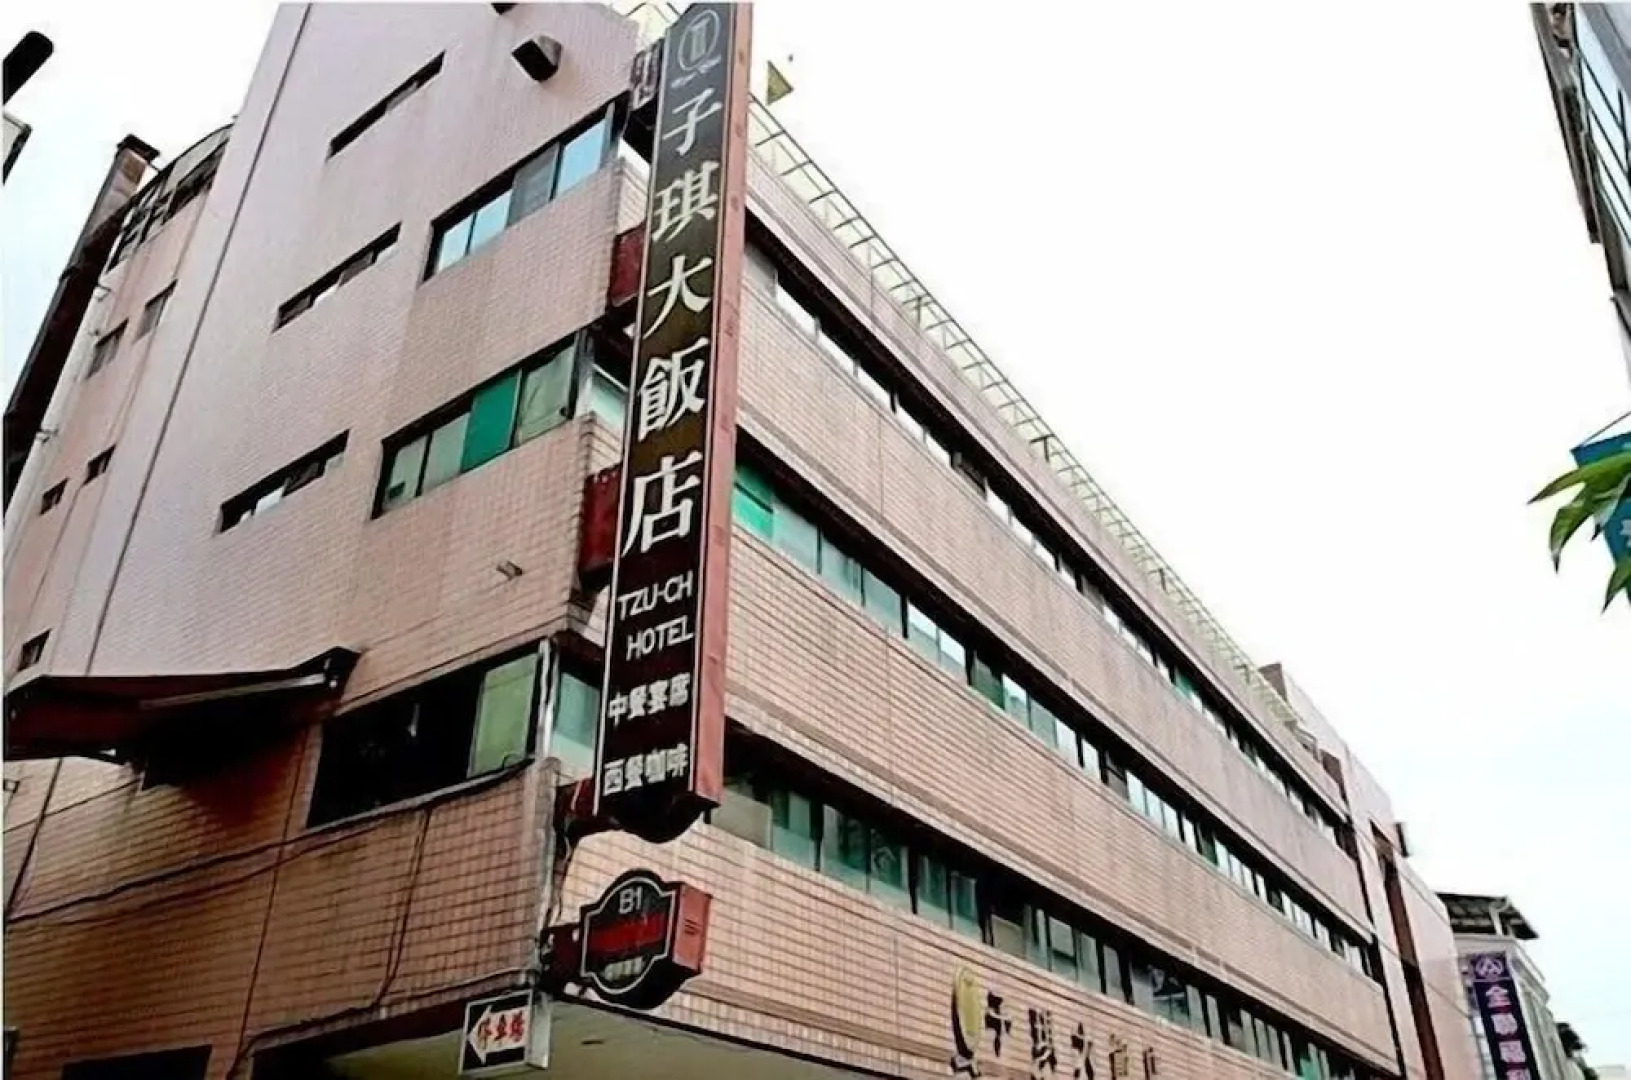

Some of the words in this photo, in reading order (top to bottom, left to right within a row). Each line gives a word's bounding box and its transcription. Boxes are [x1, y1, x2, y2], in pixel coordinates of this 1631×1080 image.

[621, 87, 722, 558] 子琪大飯店
[626, 615, 694, 661] HOTEL
[618, 886, 642, 914] B1
